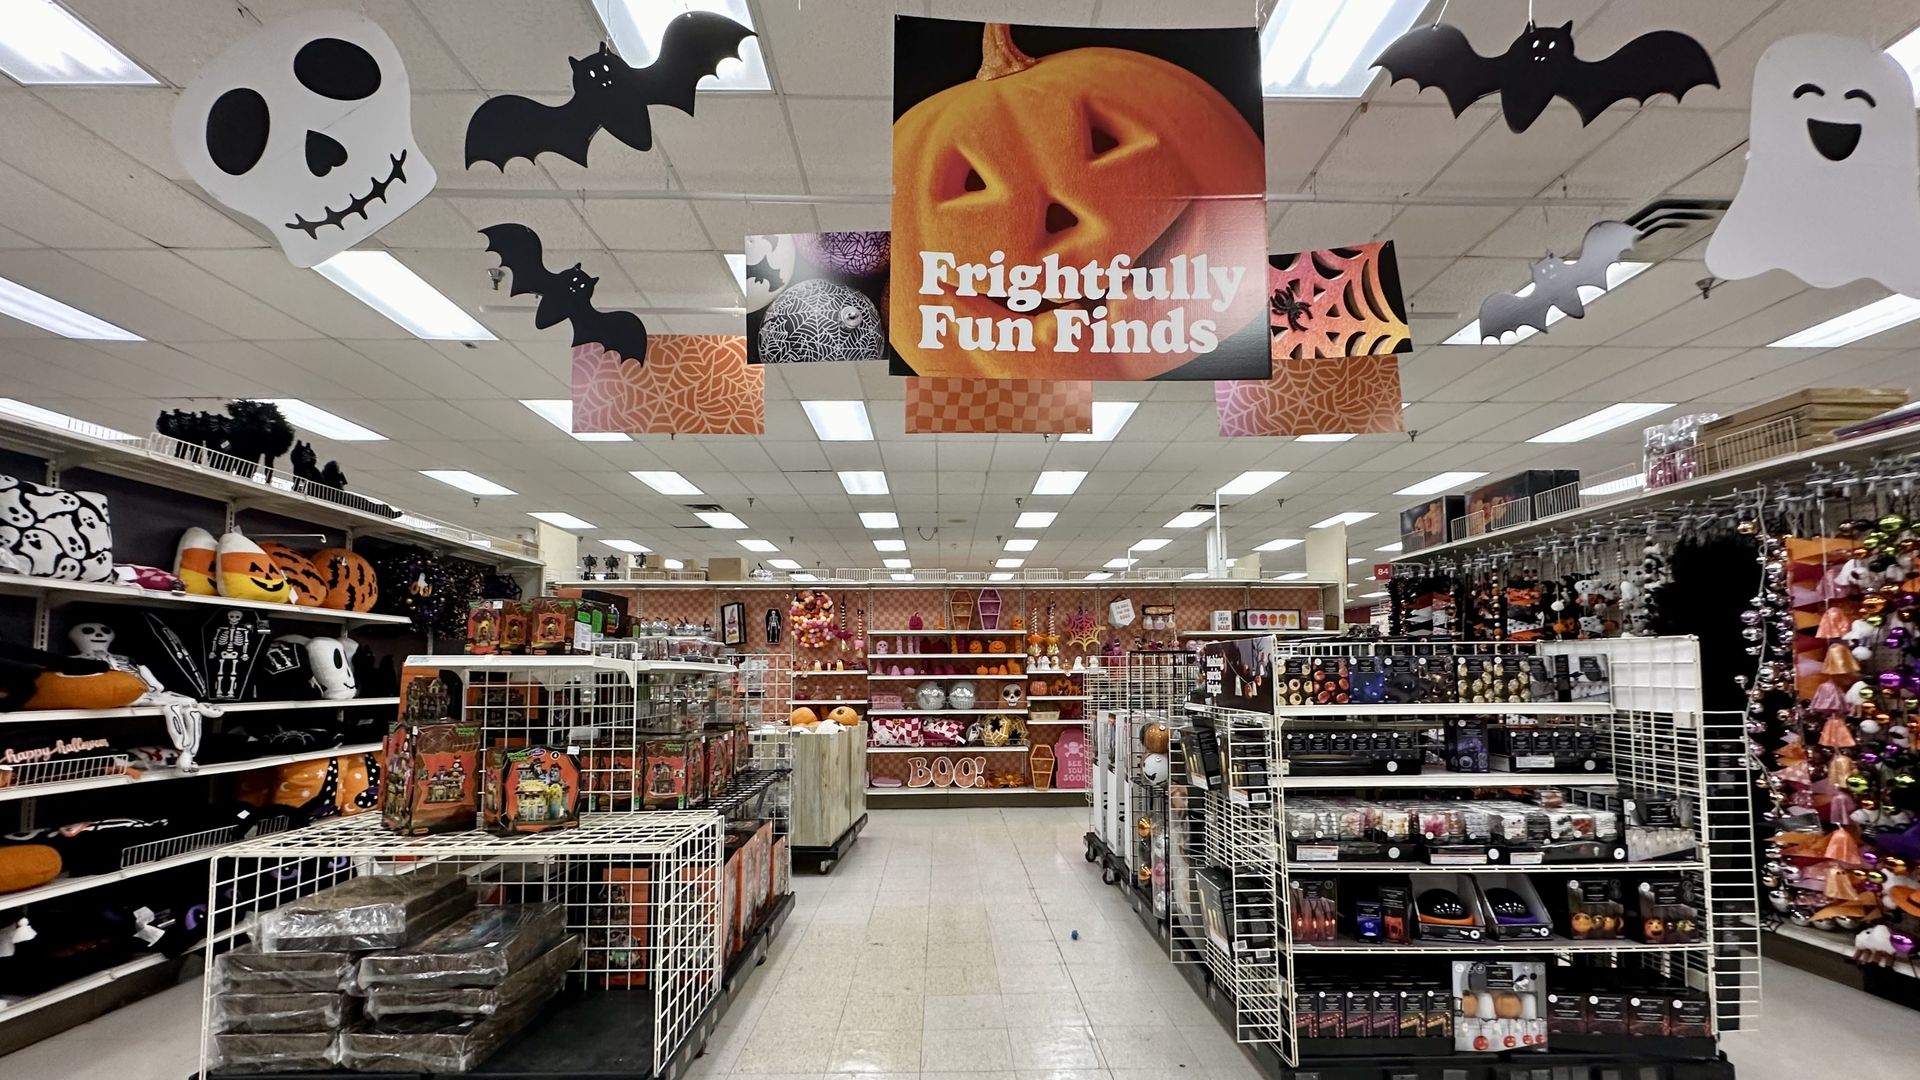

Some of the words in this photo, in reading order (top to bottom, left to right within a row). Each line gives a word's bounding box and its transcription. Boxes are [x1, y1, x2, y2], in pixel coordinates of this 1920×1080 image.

[918, 250, 1246, 312] Frightfully
[918, 304, 1036, 352] Fun
[1053, 306, 1219, 354] Finds
[908, 756, 986, 788] BOO!
